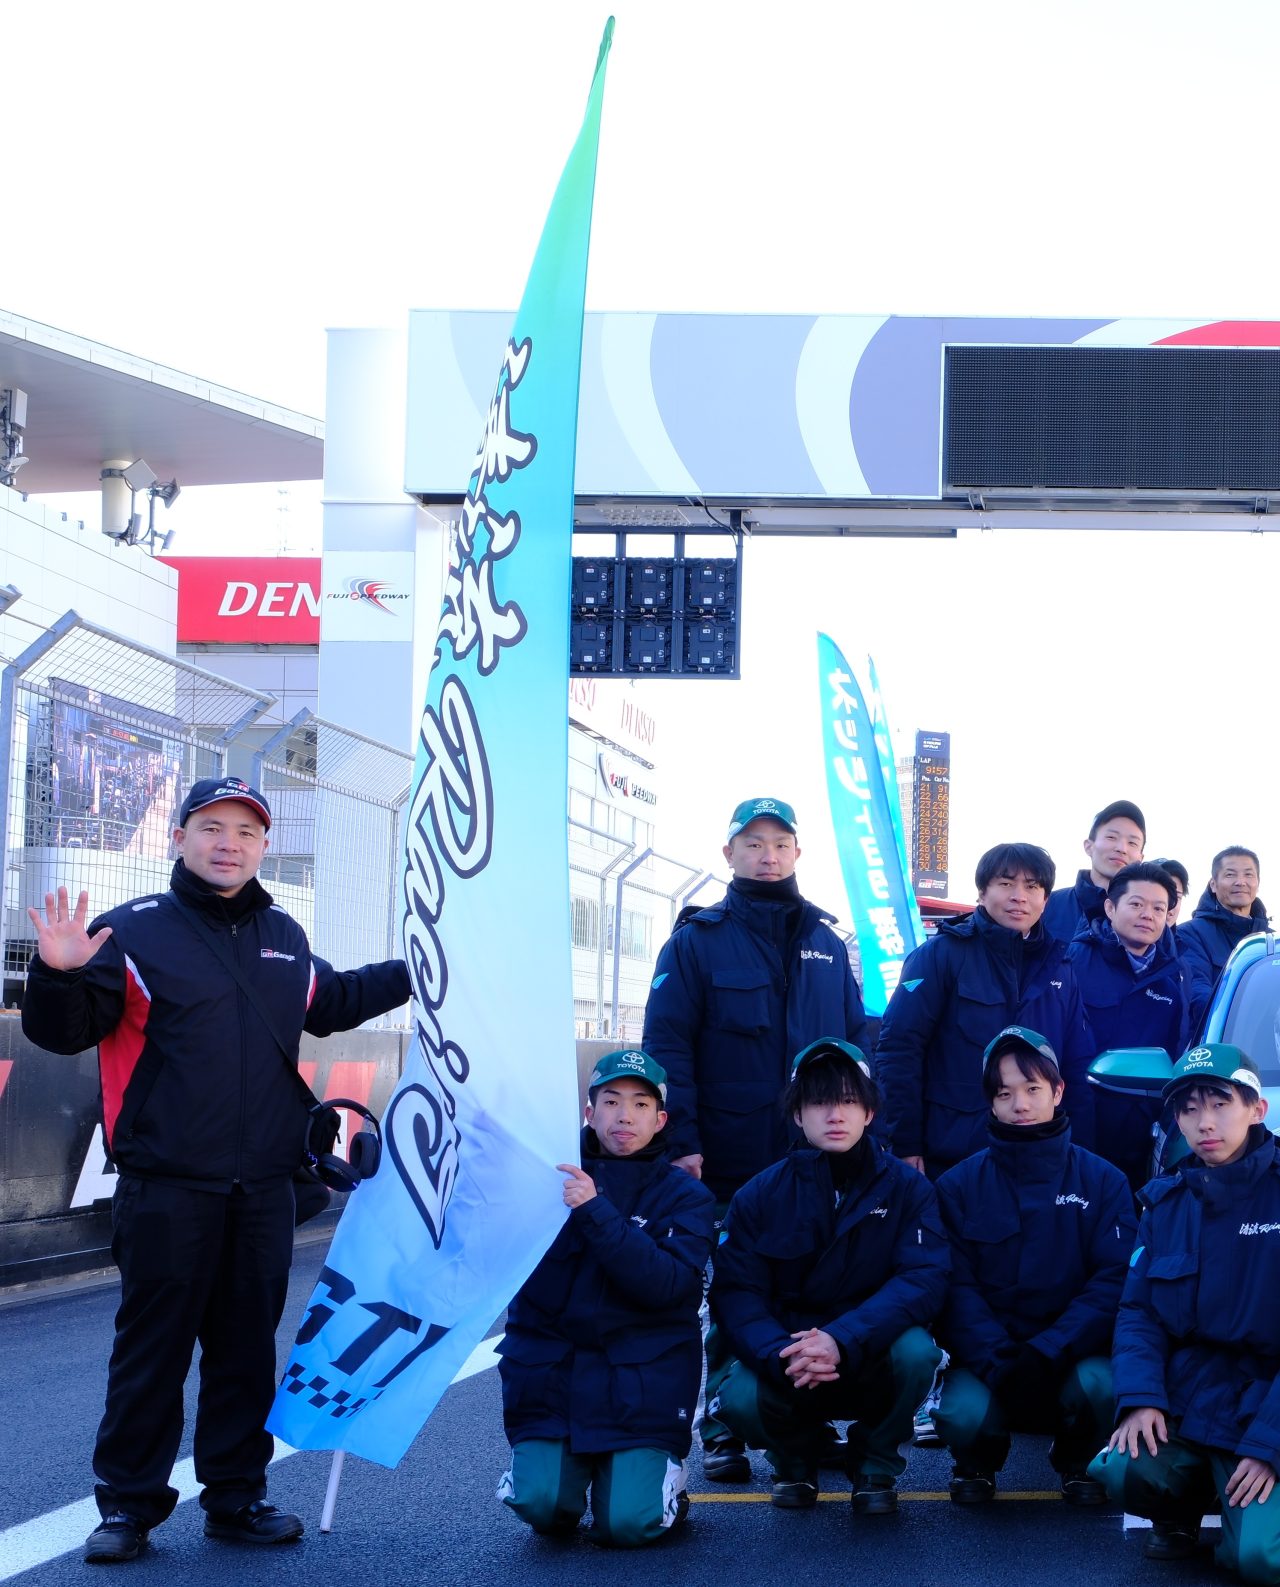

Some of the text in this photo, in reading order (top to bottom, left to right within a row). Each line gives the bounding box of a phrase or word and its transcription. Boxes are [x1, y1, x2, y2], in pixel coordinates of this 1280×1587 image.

[218, 581, 321, 617] DEN
[326, 591, 411, 601] FUJI SPEEDWAY
[926, 766, 948, 775] 9:57
[920, 783, 930, 791] 21
[919, 853, 930, 861] 29
[274, 952, 295, 961] Garage
[813, 952, 833, 963] Racing
[385, 674, 494, 1251] Racing
[1153, 994, 1173, 1005] Racing
[617, 1063, 646, 1074] TOYOTA
[1183, 1061, 1213, 1073] TOYOTA
